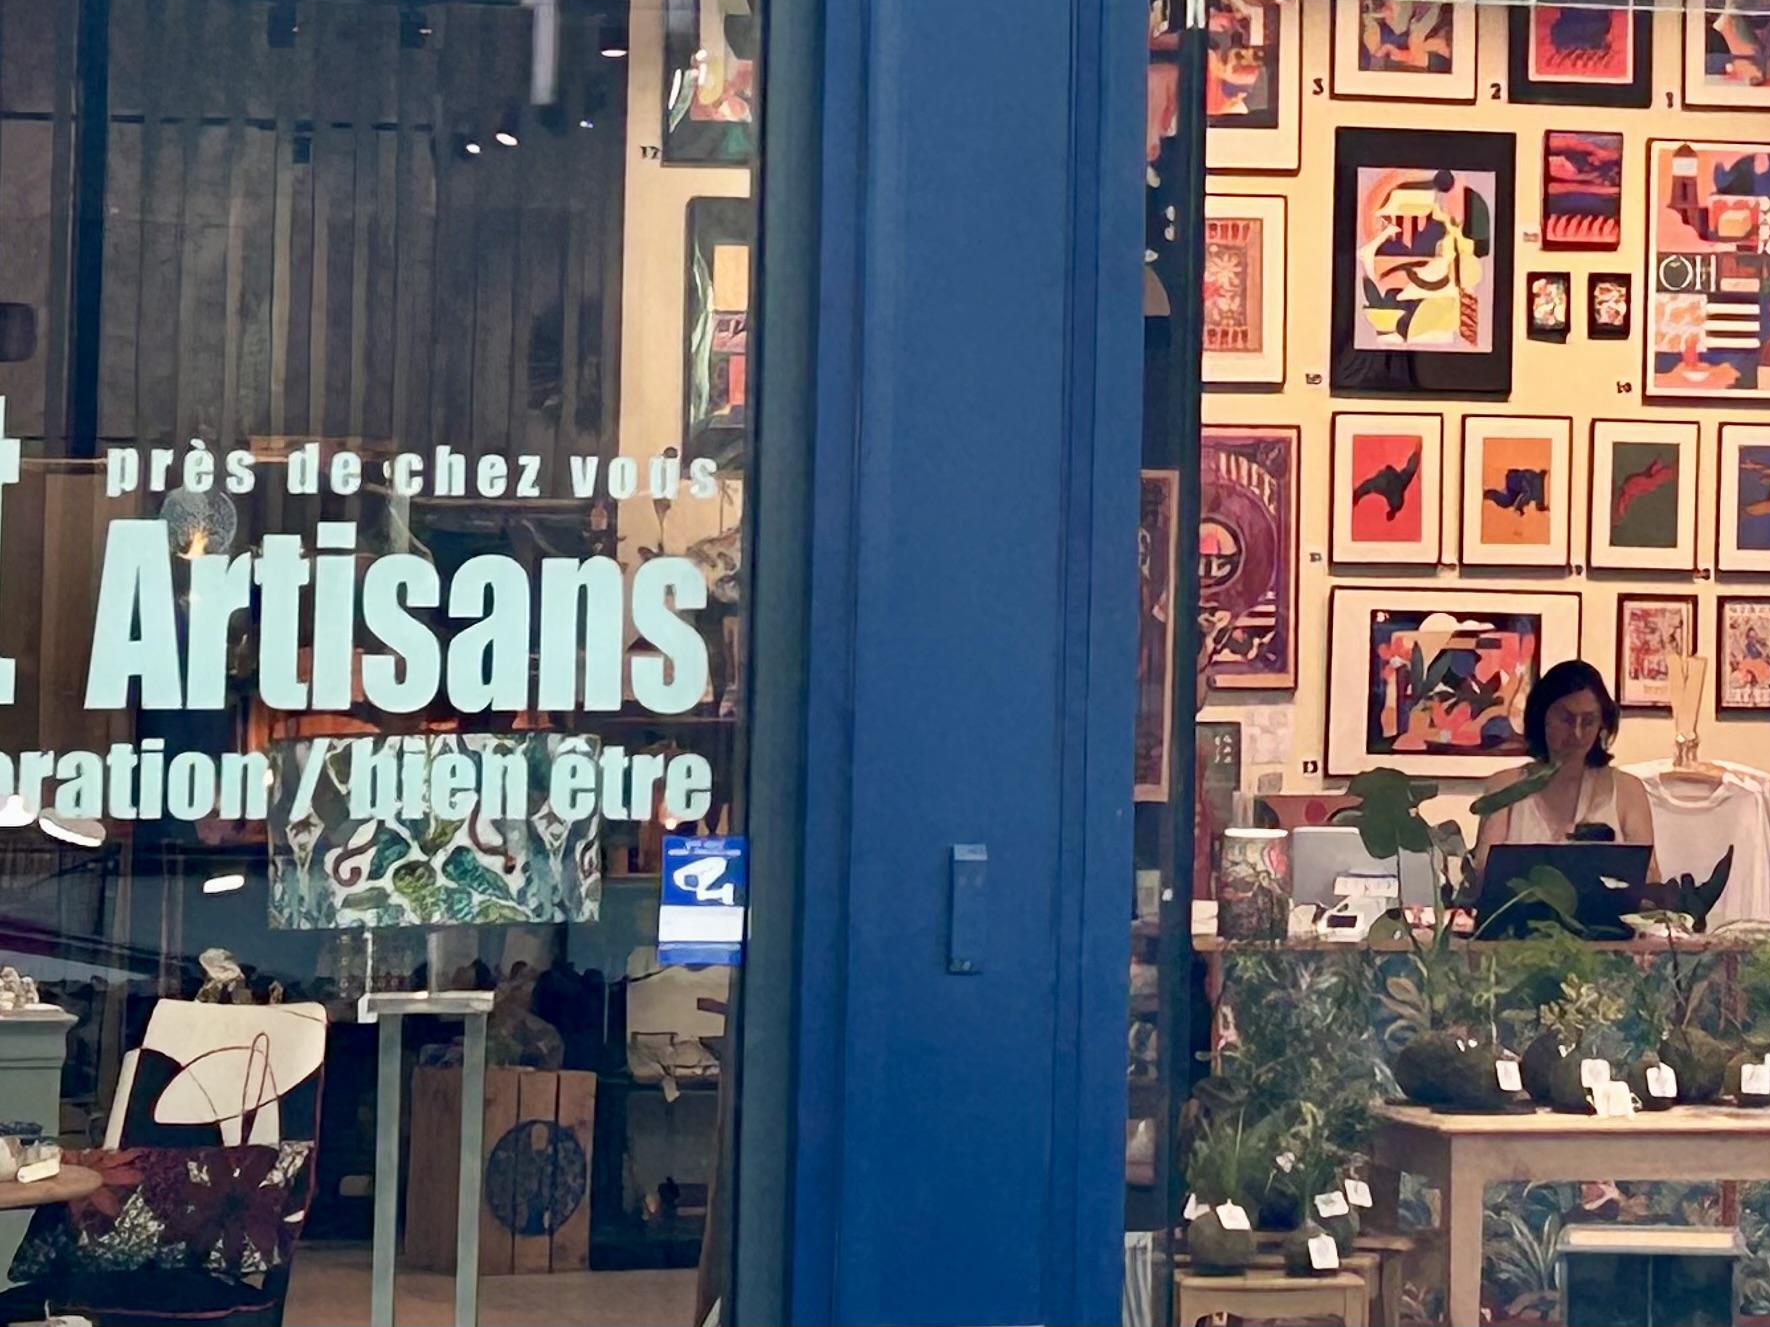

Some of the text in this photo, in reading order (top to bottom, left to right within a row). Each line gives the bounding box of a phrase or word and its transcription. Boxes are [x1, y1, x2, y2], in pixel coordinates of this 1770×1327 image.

[107, 438, 718, 499] près de chez vous
[84, 519, 709, 714] Artisans
[349, 738, 528, 821] bien
[547, 740, 713, 821] être
